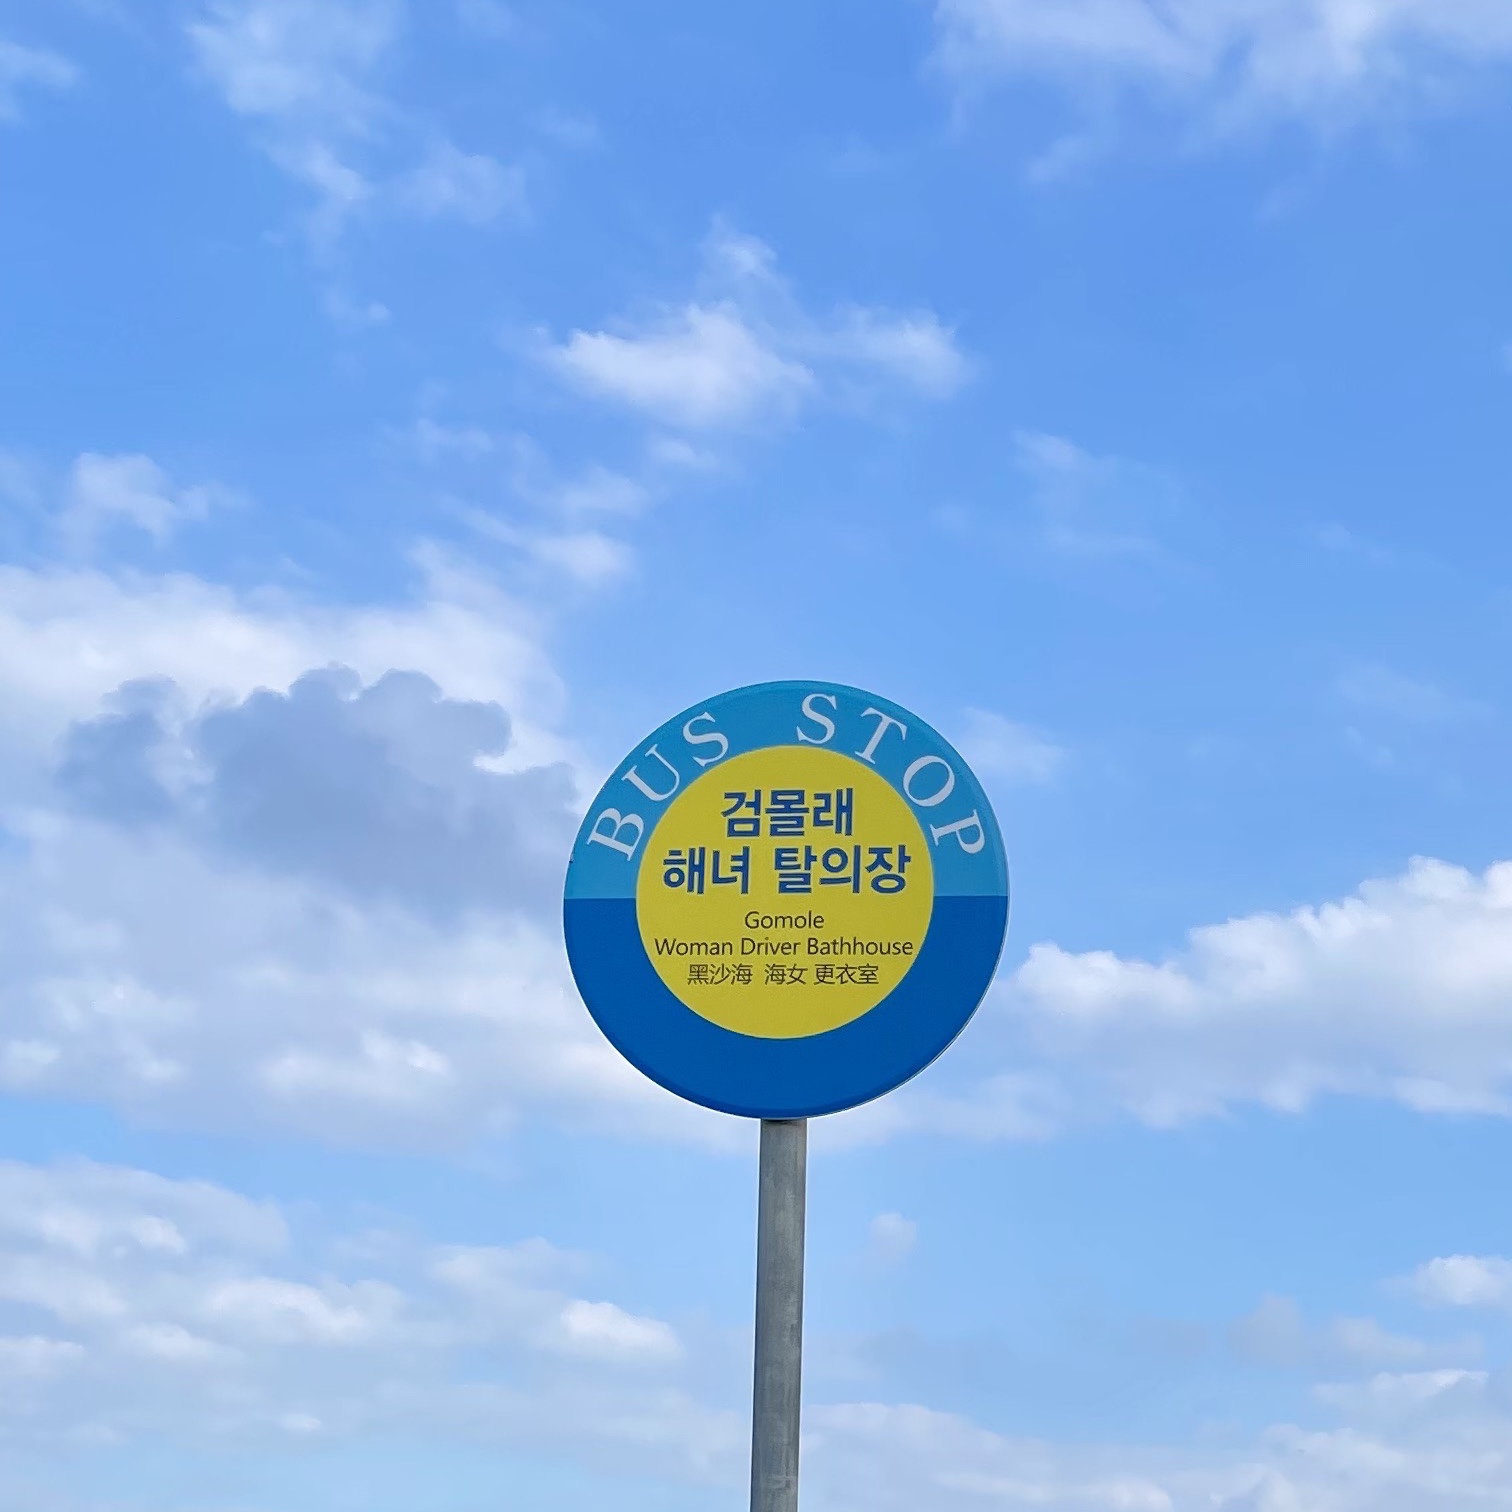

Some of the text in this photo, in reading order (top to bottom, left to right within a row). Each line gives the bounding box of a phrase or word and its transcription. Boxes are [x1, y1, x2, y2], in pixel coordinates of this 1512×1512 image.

[587, 693, 986, 861] BUS STOP
[721, 787, 854, 838] 검몰래
[663, 844, 912, 895] 해녀 탈의장
[744, 910, 825, 930] Gomole
[654, 937, 914, 956] Woman Driver Bathhouse
[764, 963, 808, 986] 海女
[813, 963, 880, 986] 更衣室
